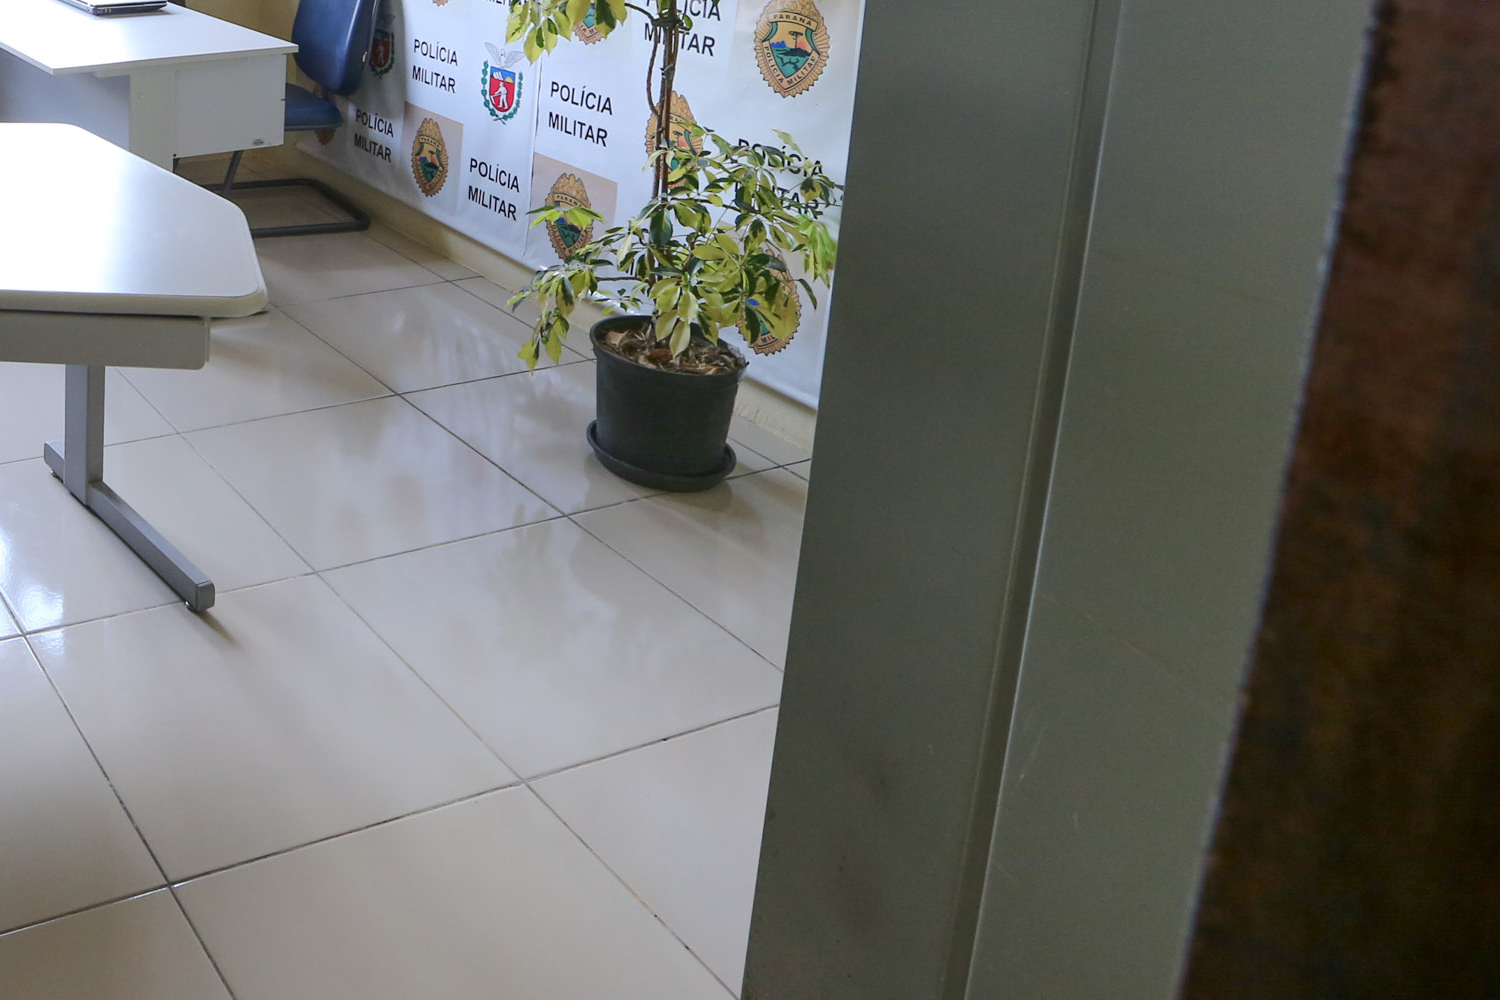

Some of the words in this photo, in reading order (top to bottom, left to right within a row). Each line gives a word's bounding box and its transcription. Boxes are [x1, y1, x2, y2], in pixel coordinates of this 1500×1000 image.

[413, 39, 458, 66] POLÍCIA
[644, 22, 716, 57] MITAR
[412, 65, 456, 94] MILITAR
[550, 81, 613, 116] POLÍCIA
[355, 108, 394, 138] POLÍCIA
[548, 111, 608, 147] MILITAR
[354, 133, 391, 163] MILITAR
[469, 157, 520, 193] POLÍCIA
[467, 185, 517, 221] MILITAR
